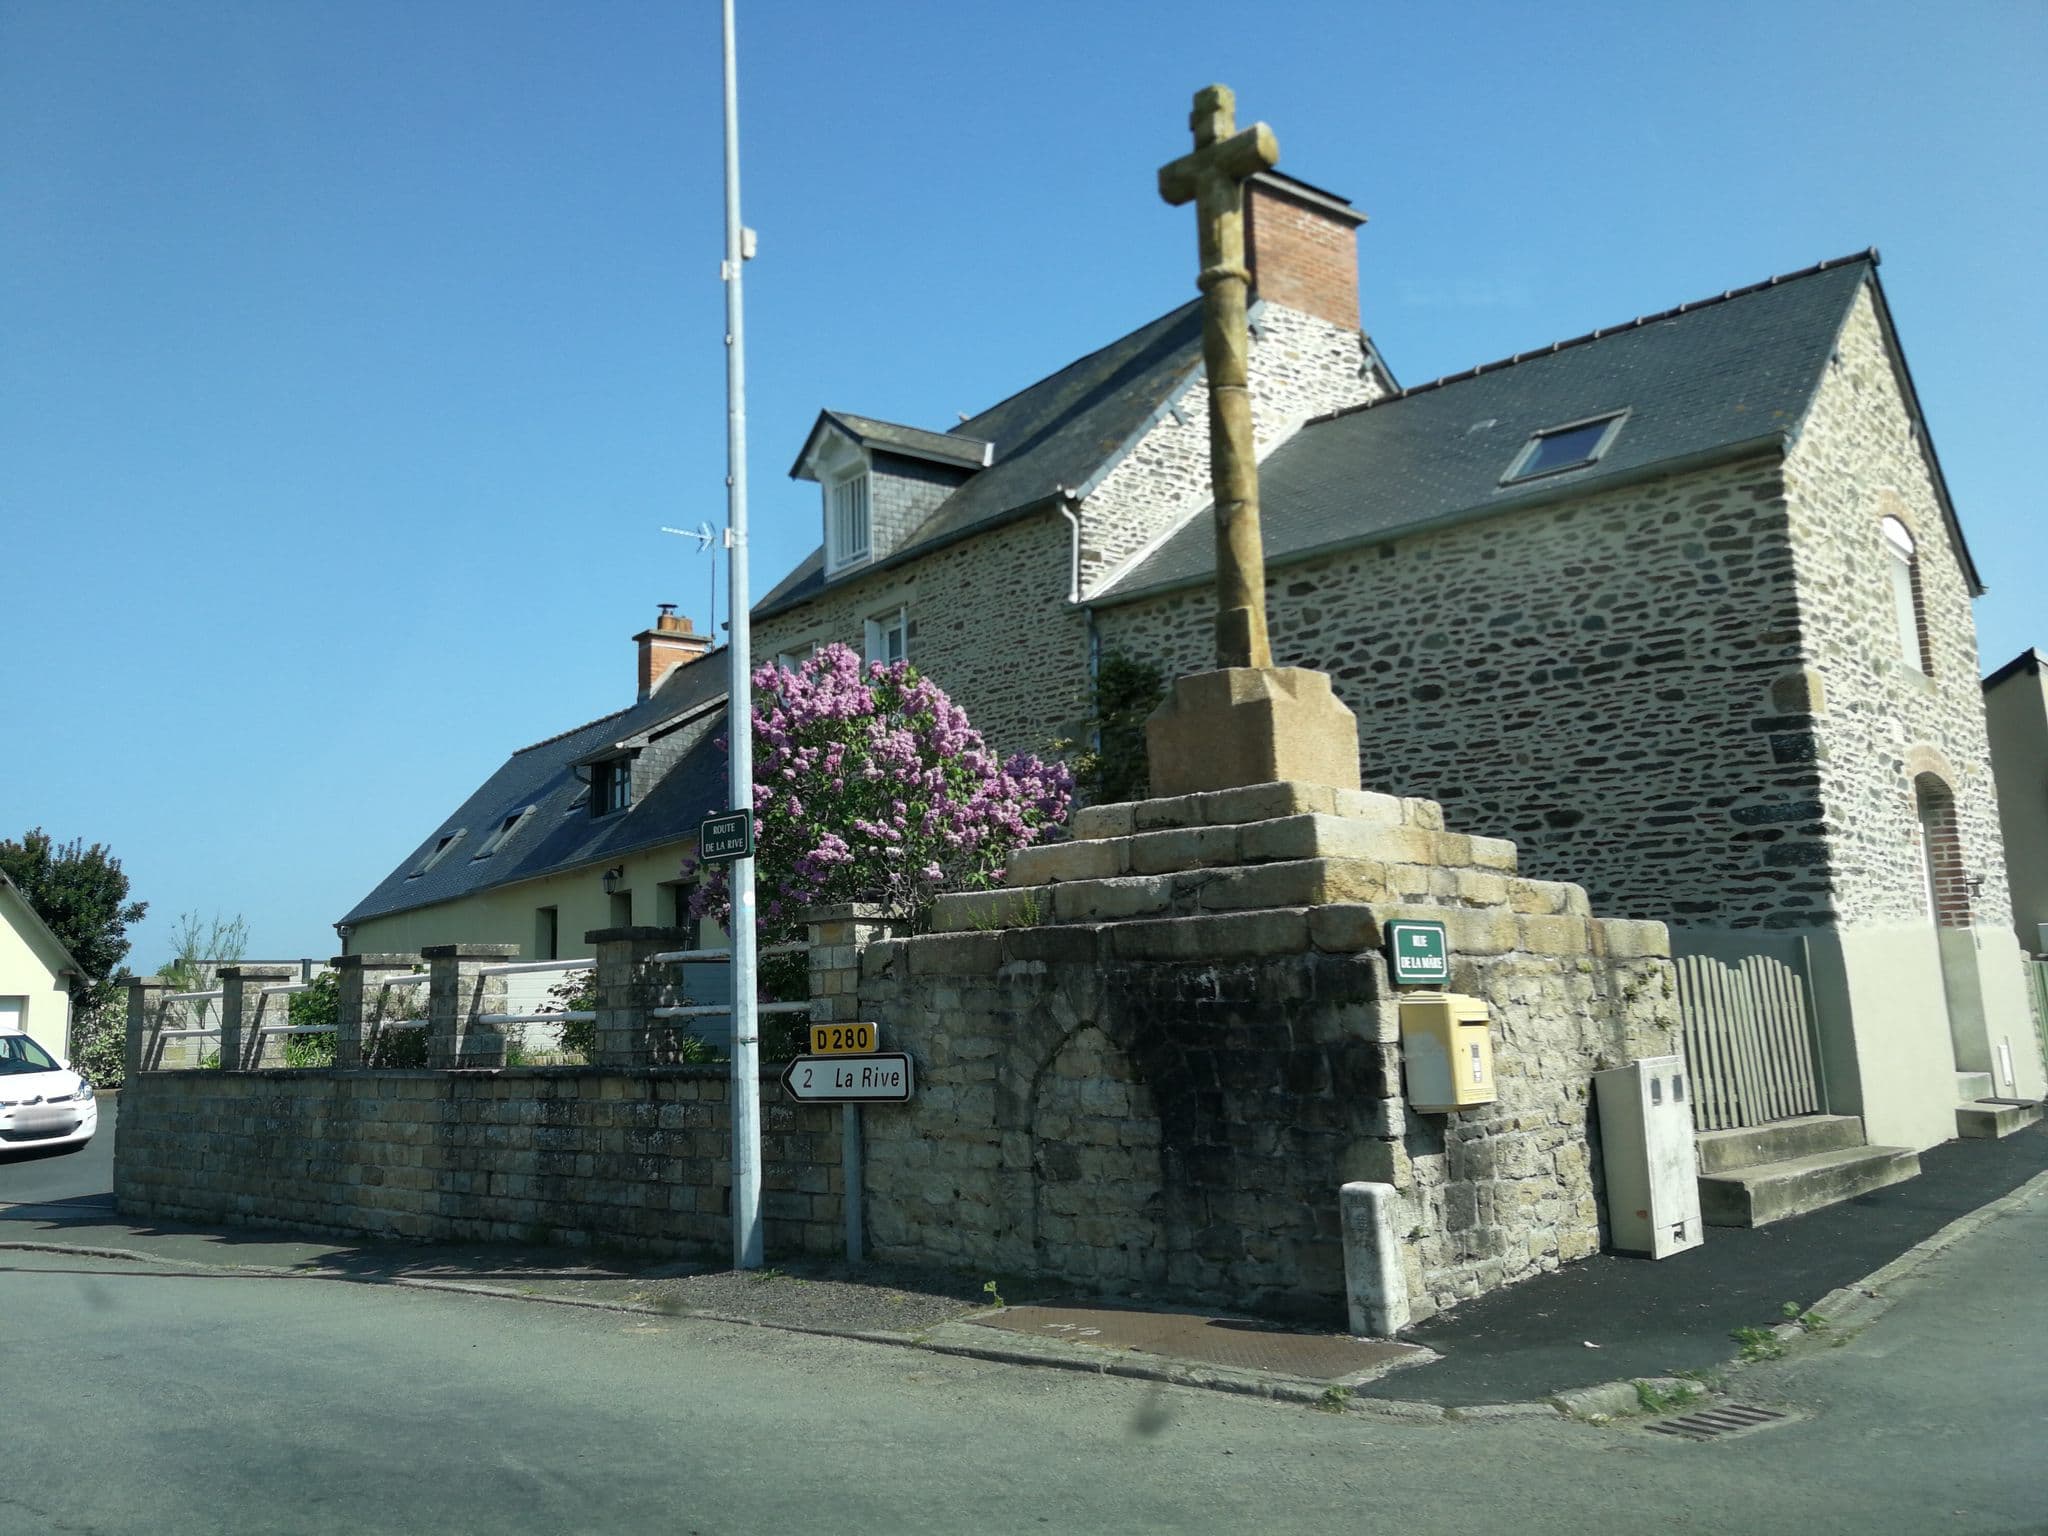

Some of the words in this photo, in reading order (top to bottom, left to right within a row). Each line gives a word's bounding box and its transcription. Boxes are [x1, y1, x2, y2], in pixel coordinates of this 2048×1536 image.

[713, 822, 736, 835] ROUTE
[705, 842, 715, 853] DE
[716, 841, 726, 851] LA
[727, 838, 744, 849] RIVE
[1412, 935, 1429, 947] RUE
[1400, 956, 1411, 969] DE
[1411, 956, 1422, 969] LA
[817, 1030, 827, 1050] D
[832, 1027, 868, 1049] 280
[803, 1068, 813, 1088] 2
[835, 1067, 854, 1088] La
[861, 1066, 900, 1088] Rive
